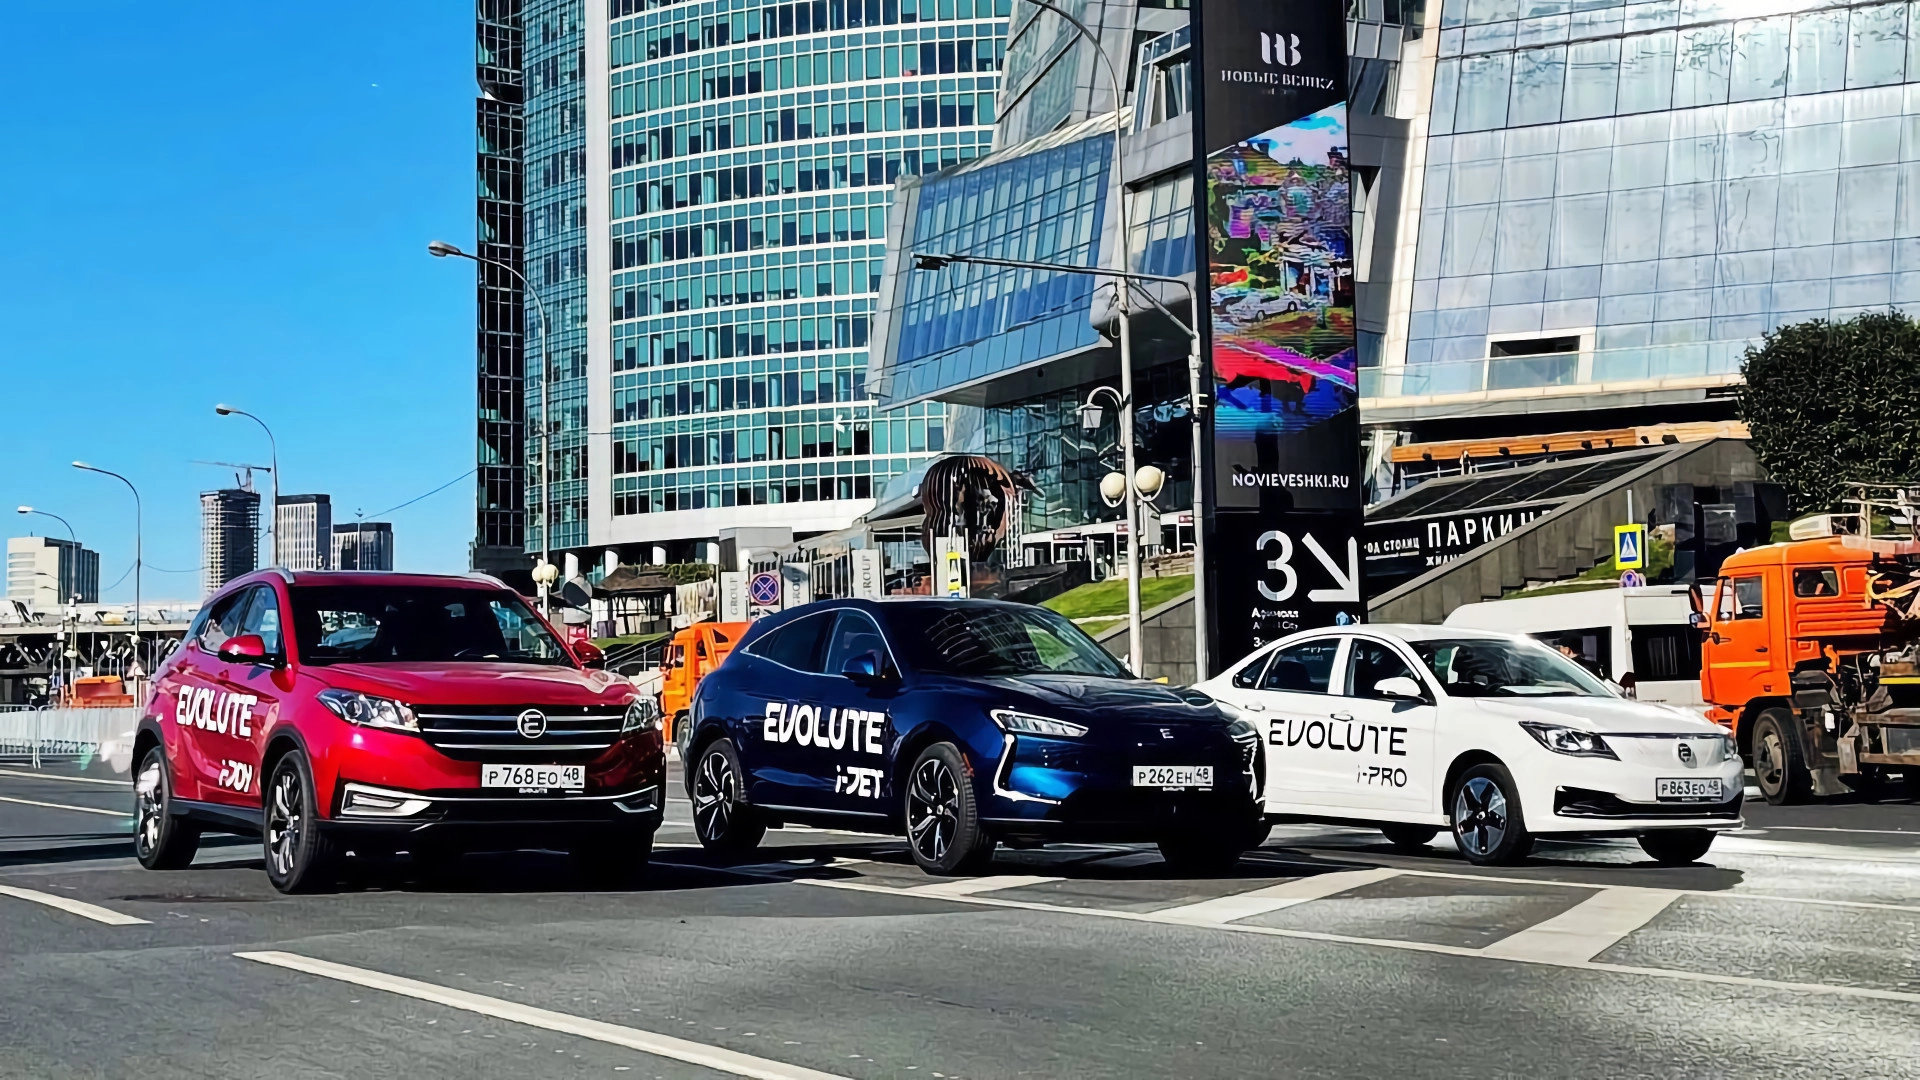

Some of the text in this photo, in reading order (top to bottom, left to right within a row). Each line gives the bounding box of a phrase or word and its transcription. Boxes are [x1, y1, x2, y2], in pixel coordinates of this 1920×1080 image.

[1232, 473, 1349, 489] NOVIEVESHKI.RU
[1427, 509, 1553, 548] ПАРКИ
[1256, 530, 1298, 601] 3
[176, 685, 258, 737] EVOLUTE
[764, 702, 885, 754] EVOLUTE
[1269, 718, 1408, 756] EVOLUTE
[218, 759, 253, 793] i-JOY
[562, 767, 580, 781] 48
[835, 764, 884, 799] i-JET
[1196, 767, 1210, 780] 48
[1357, 764, 1408, 788] i-PRO
